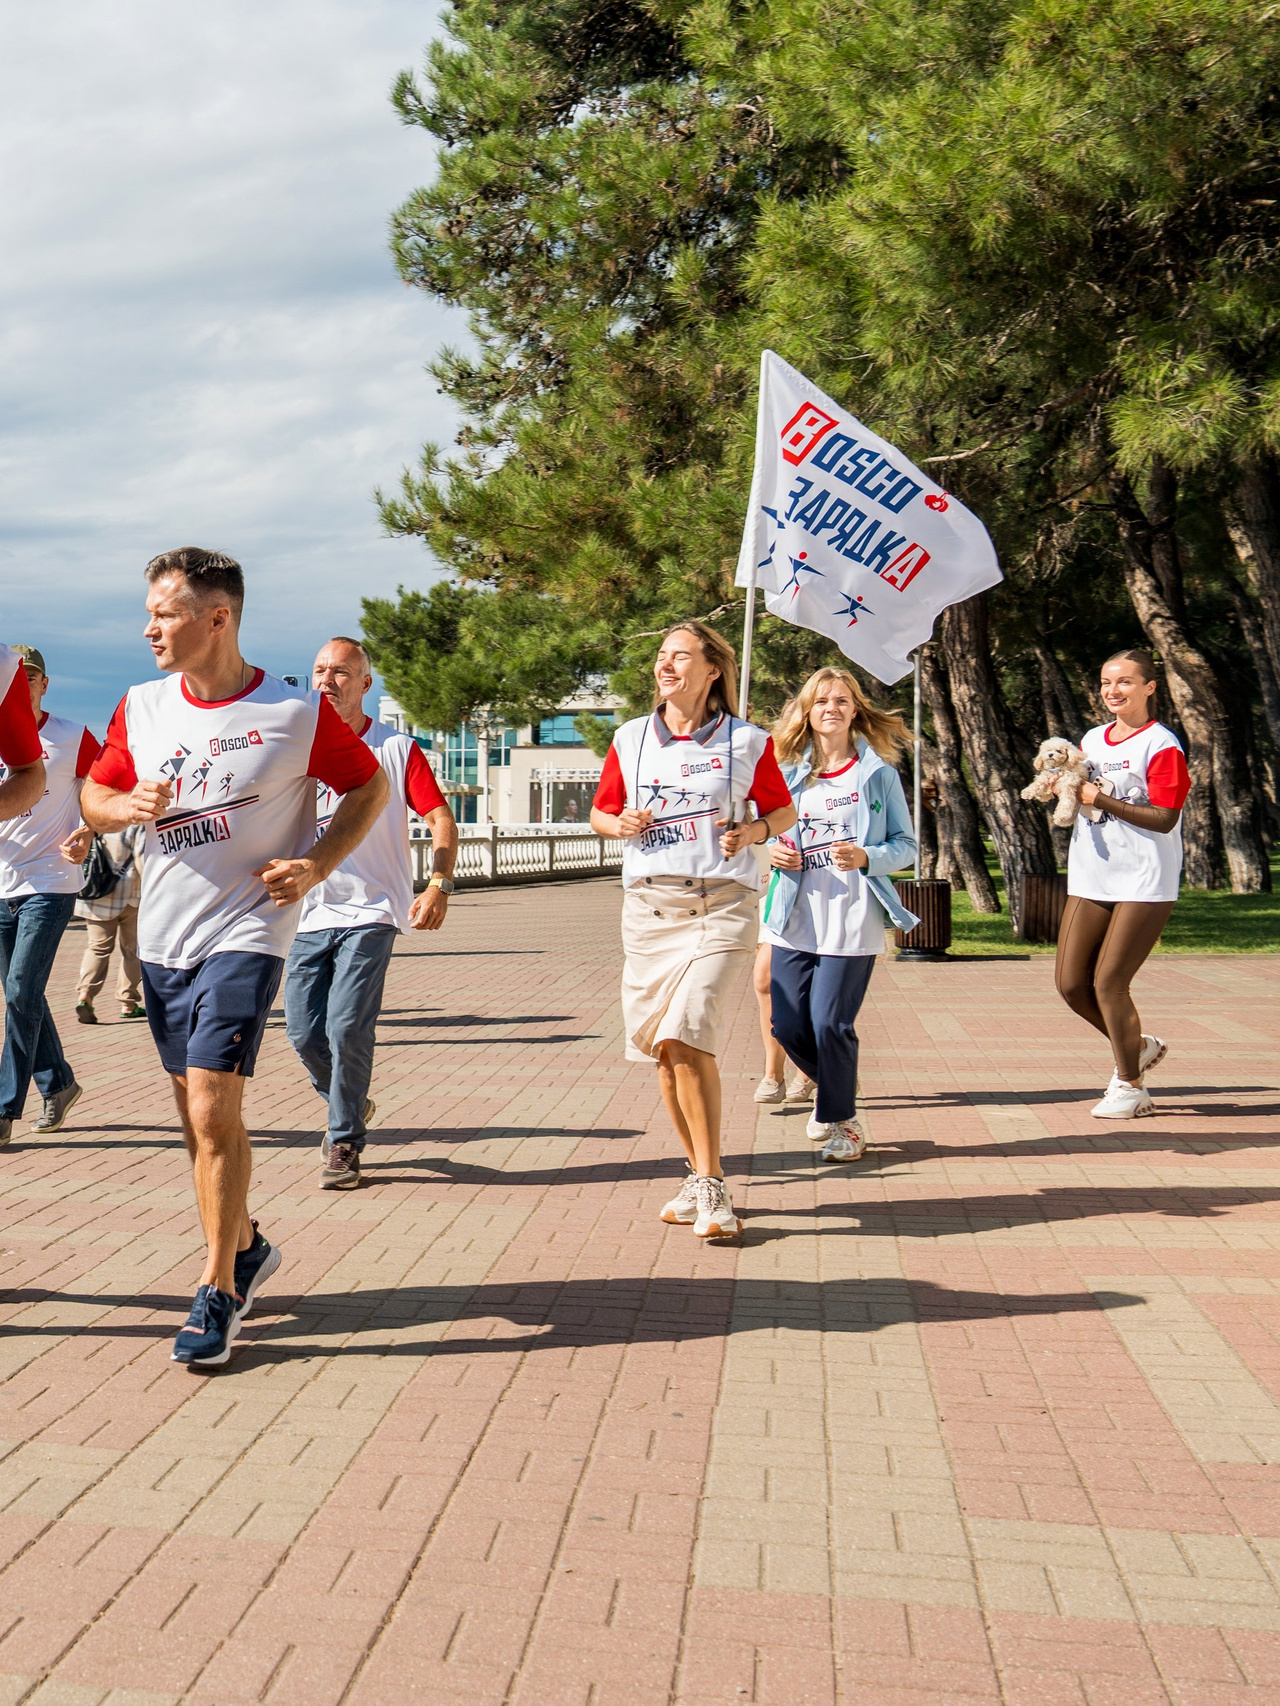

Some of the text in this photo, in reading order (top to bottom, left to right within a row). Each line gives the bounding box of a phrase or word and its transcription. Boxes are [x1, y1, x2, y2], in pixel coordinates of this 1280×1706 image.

[781, 401, 923, 514] BOSCO
[785, 476, 931, 592] ЗАРЯДКА
[209, 736, 249, 756] BOSCO
[681, 763, 711, 777] BOSCO
[826, 797, 851, 810] BOSCO
[158, 815, 231, 854] ЗАРЯДКА
[640, 821, 697, 851] ЗАРЯДКА
